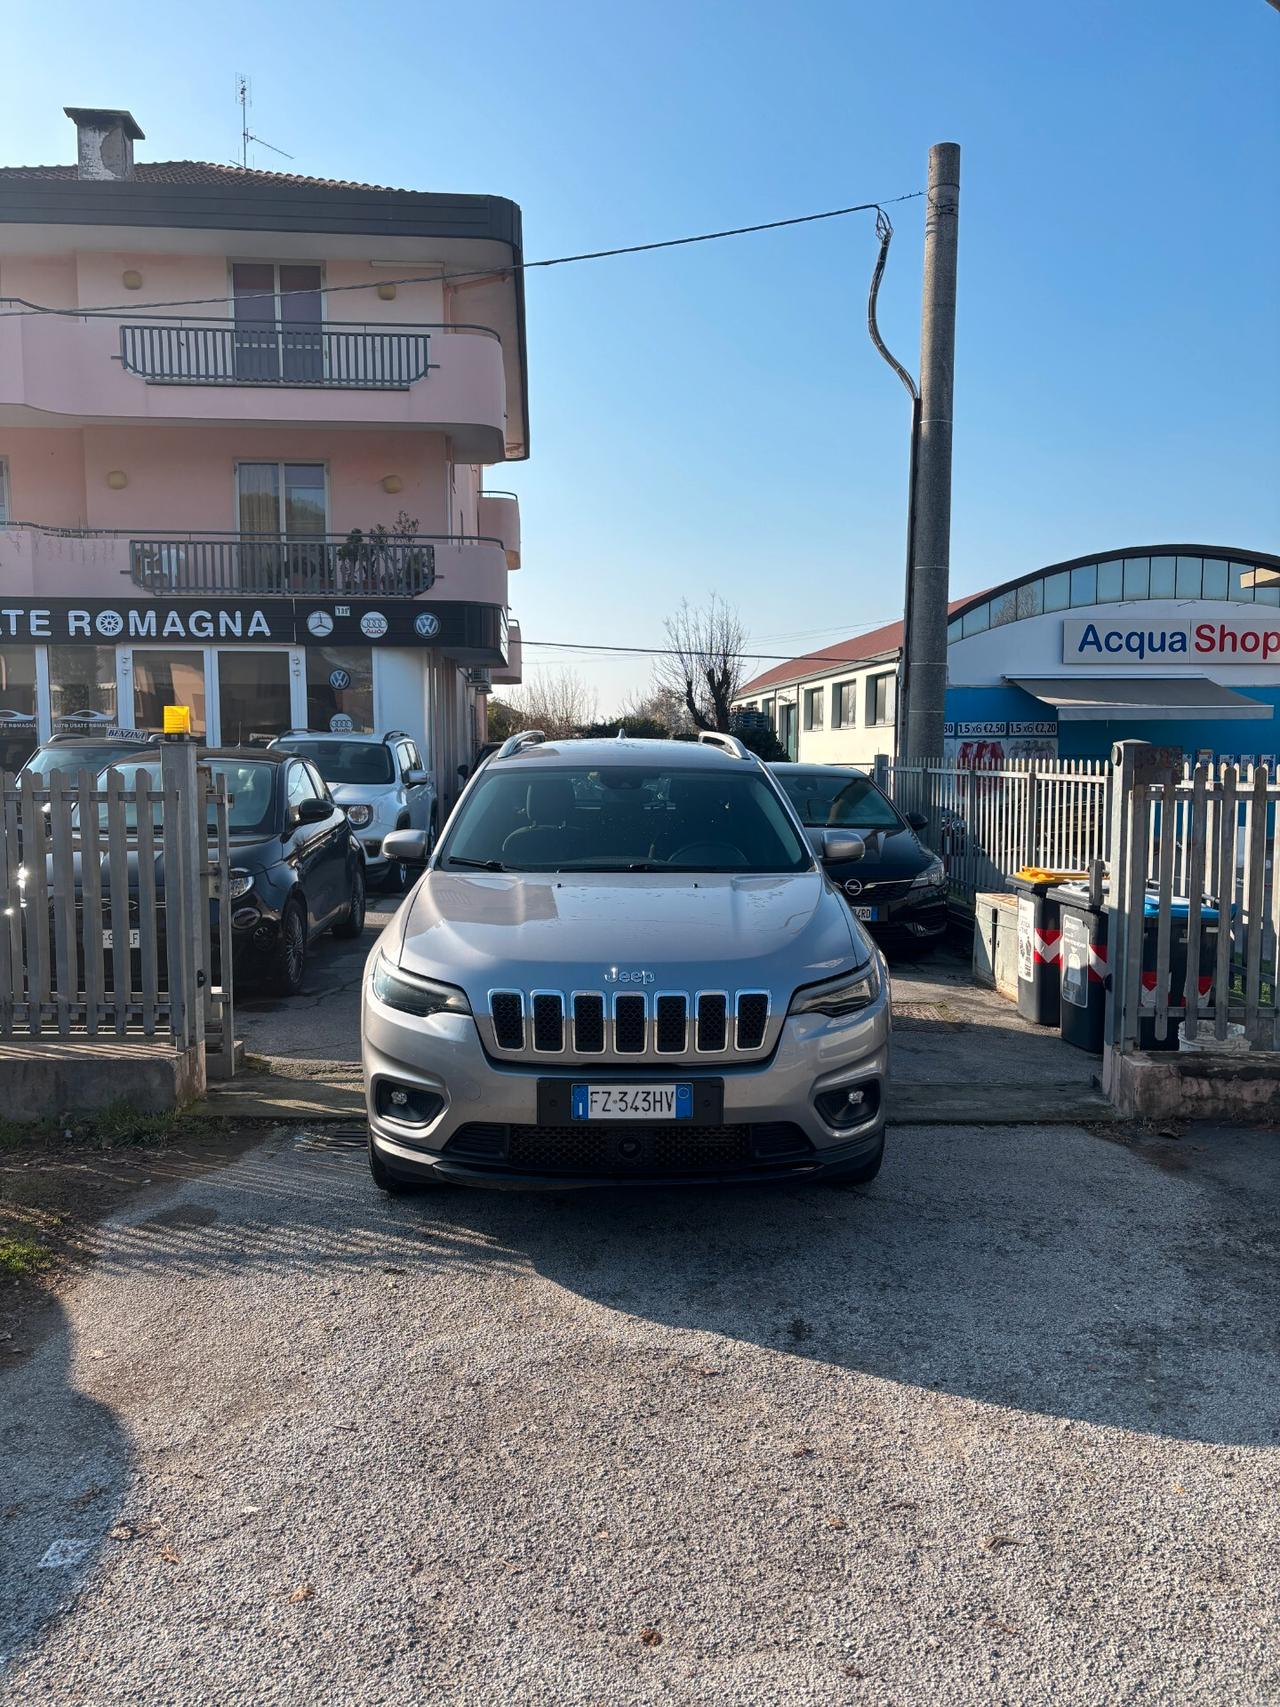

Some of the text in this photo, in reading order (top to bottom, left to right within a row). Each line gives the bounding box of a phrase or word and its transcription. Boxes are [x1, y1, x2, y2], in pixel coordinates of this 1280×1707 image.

[0, 610, 271, 637] TE ROMAGNA
[1078, 624, 1280, 660] Acqua Shop
[604, 967, 655, 985] Jeep
